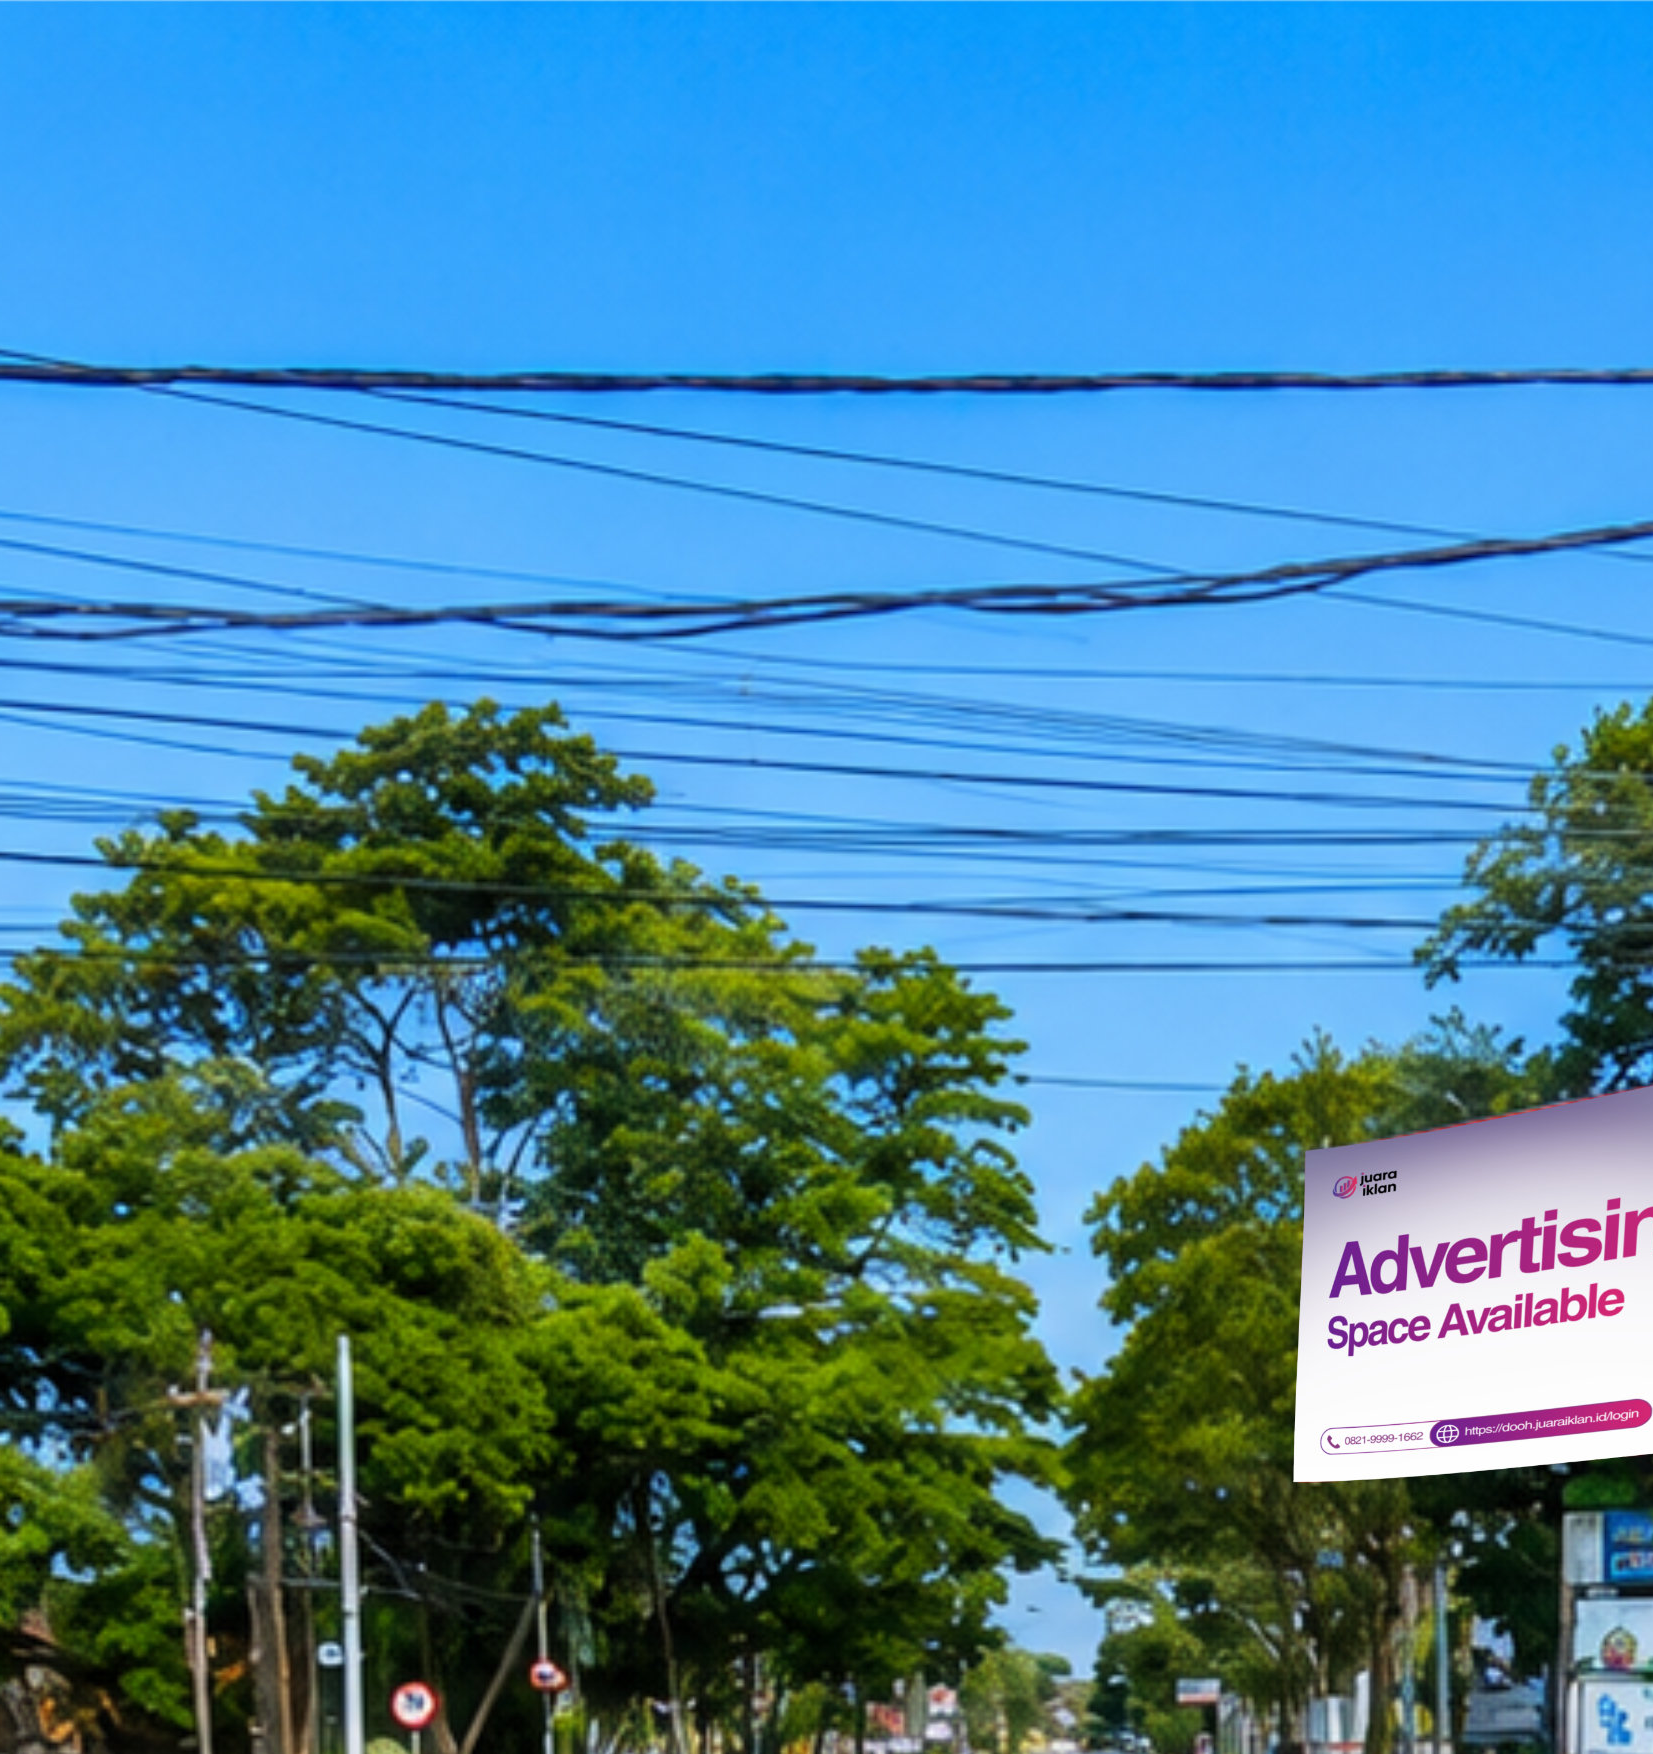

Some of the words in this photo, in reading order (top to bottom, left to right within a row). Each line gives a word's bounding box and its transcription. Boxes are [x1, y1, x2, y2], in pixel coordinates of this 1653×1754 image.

[1360, 1169, 1398, 1184] juara
[1361, 1182, 1397, 1196] iklan
[1328, 1316, 1430, 1356] Space
[1438, 1283, 1624, 1338] Available
[1345, 1432, 1423, 1445] 0821-9999-1662
[1466, 1410, 1639, 1436] https://dooh.juaraiklan.id/login
